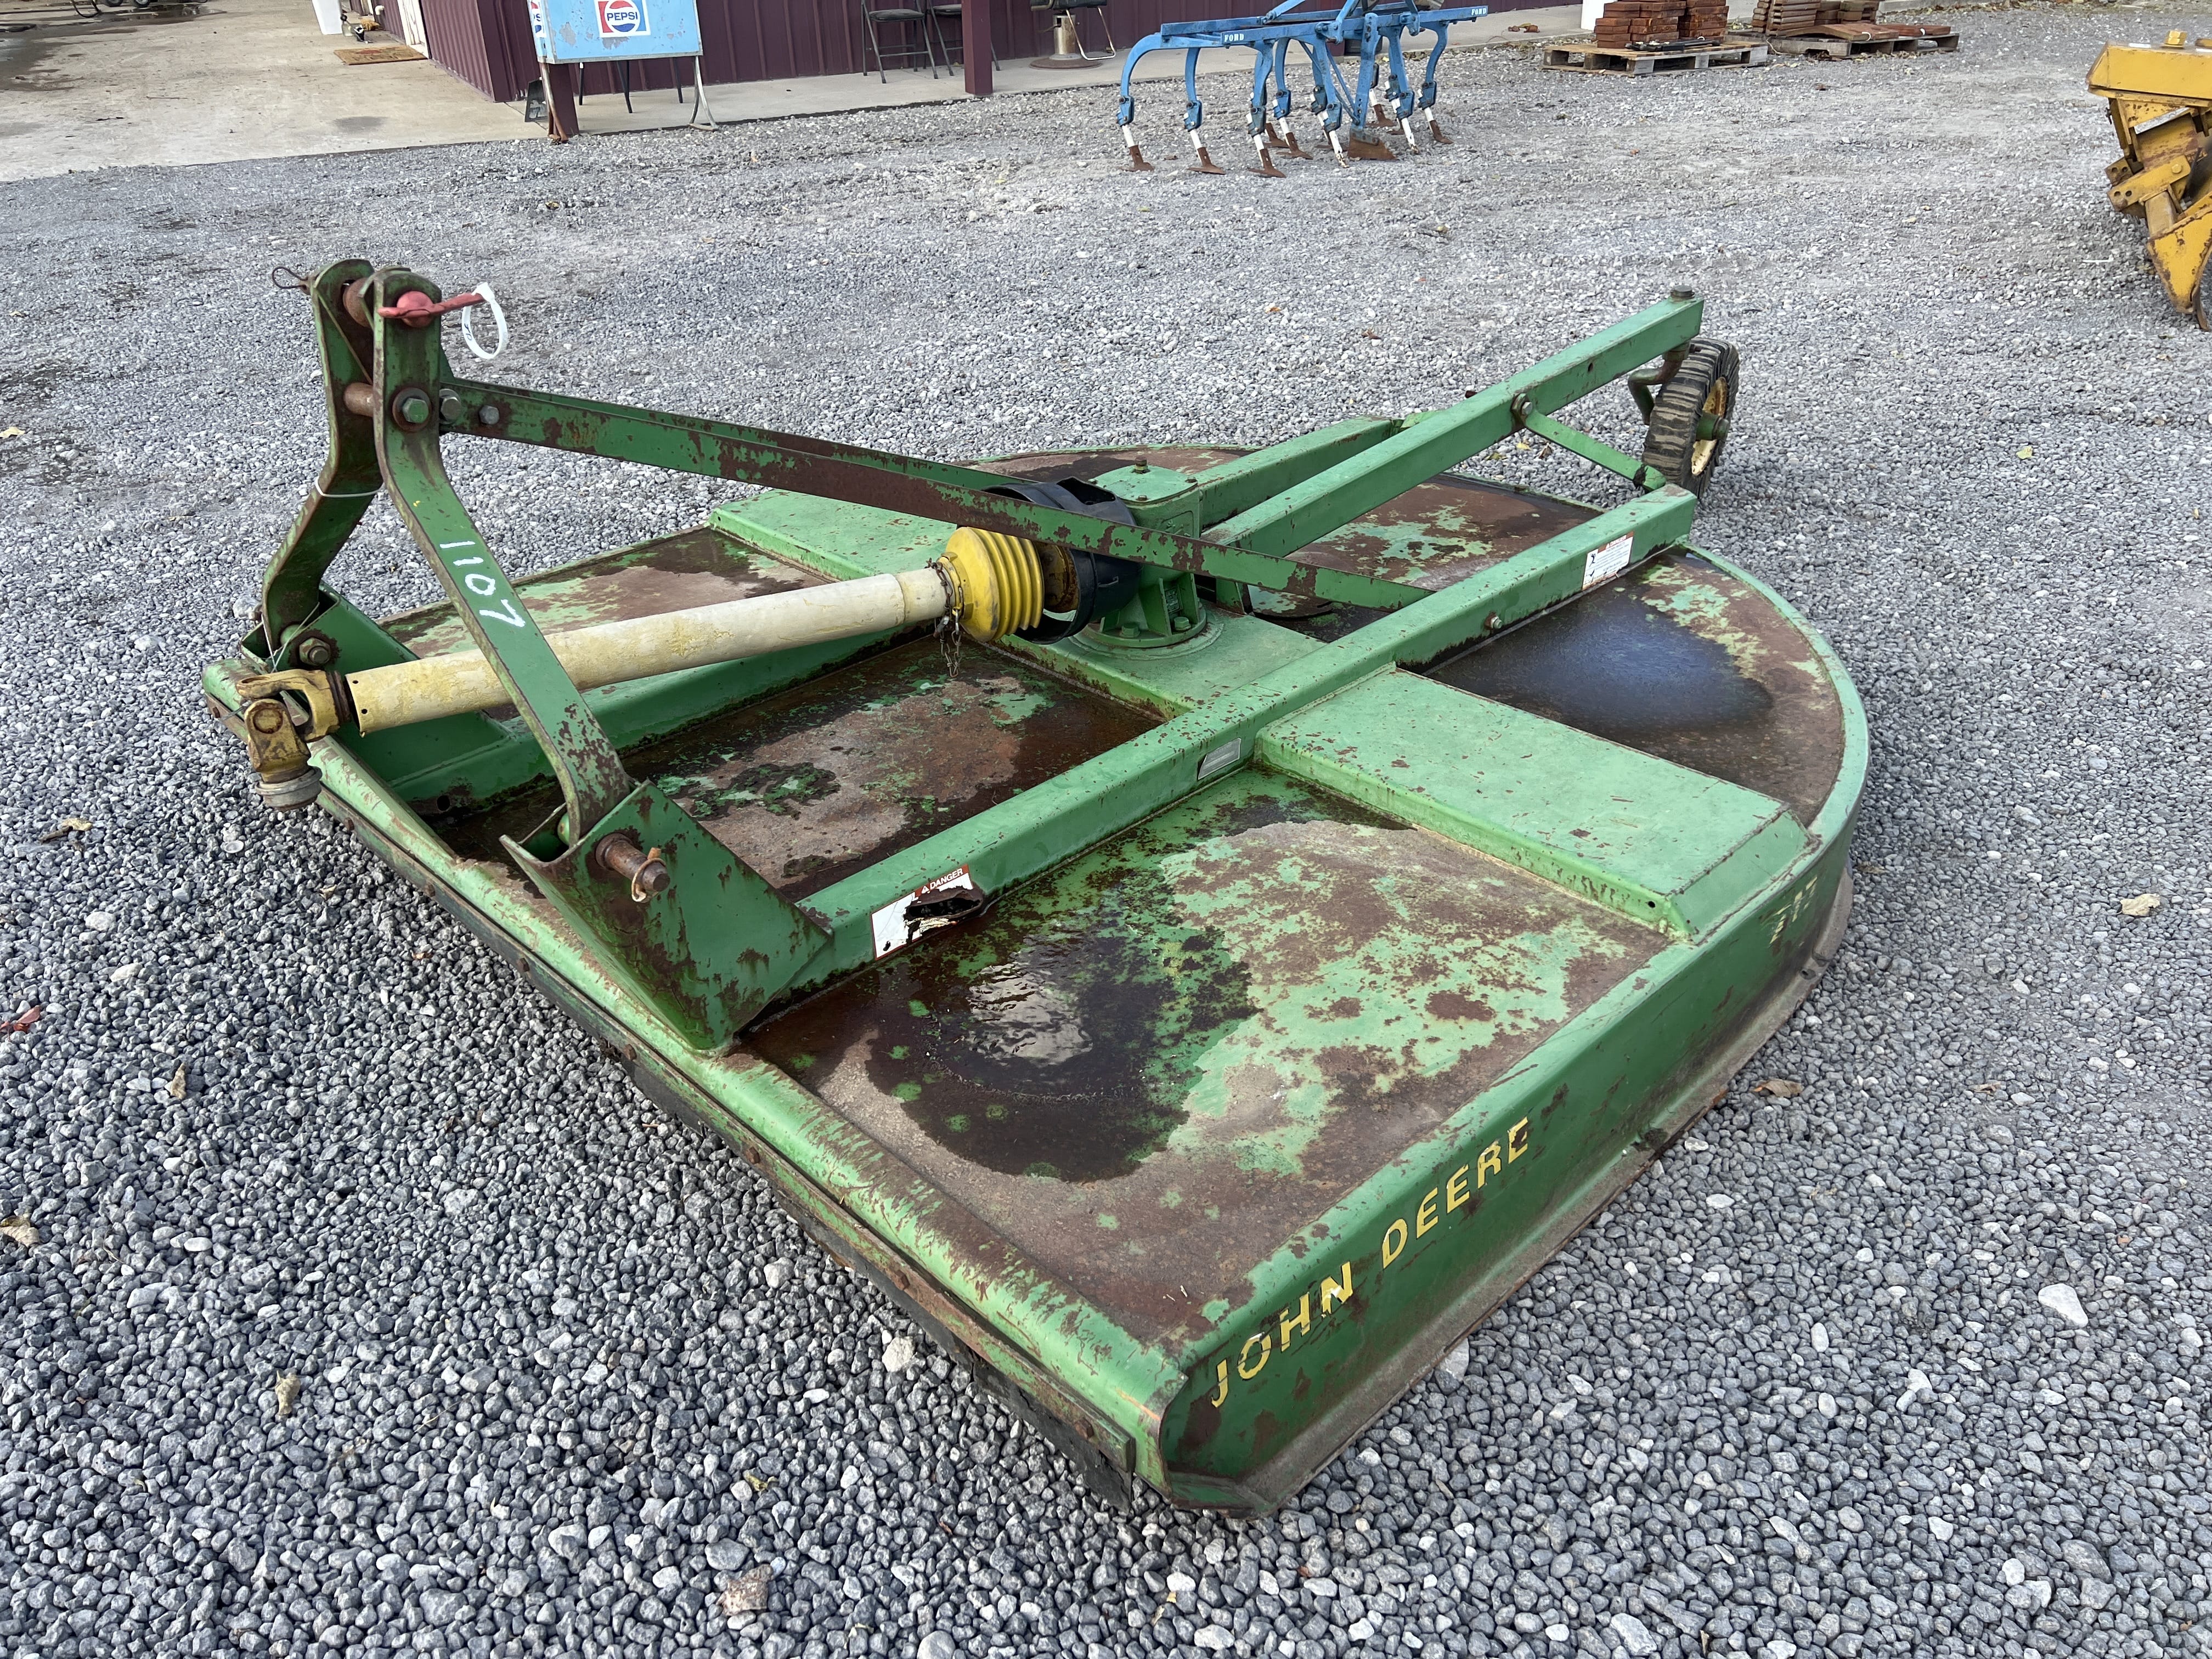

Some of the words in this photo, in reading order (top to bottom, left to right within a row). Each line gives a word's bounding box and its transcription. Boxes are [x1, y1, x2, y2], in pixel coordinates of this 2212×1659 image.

[606, 12, 638, 21] PEPSI
[1224, 33, 1244, 42] FORD
[439, 540, 526, 628] 1107
[930, 868, 963, 890] DANGER
[1211, 1261, 1354, 1408] JOHN
[1382, 1116, 1529, 1269] DEERE
